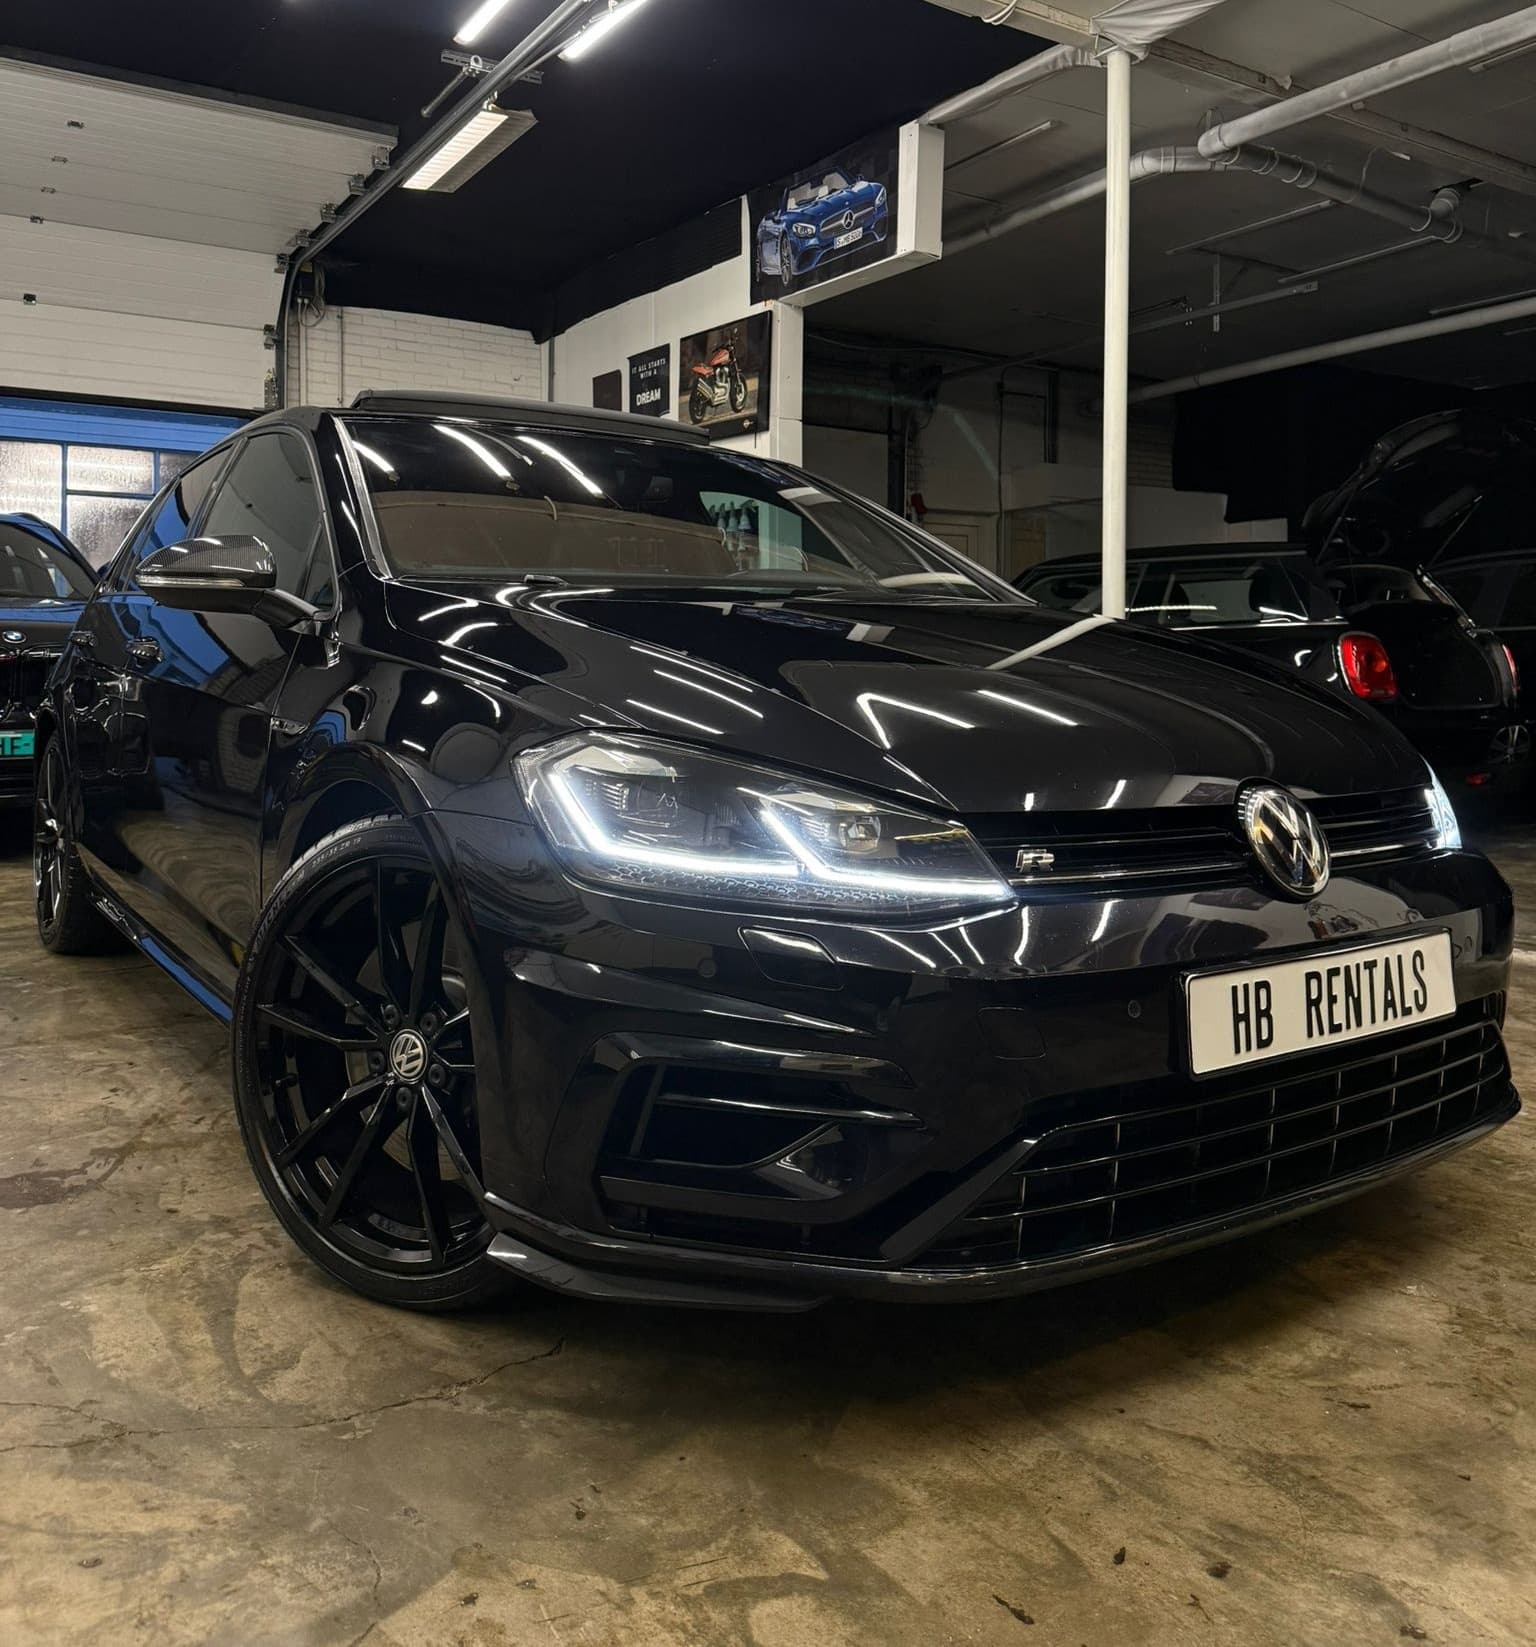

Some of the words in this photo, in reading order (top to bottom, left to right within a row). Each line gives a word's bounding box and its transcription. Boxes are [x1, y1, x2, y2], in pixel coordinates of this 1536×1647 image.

[648, 358, 666, 369] STARTS
[640, 371, 652, 379] WITH
[636, 388, 661, 406] DREAM
[1231, 979, 1274, 1055] HB
[1304, 949, 1428, 1039] RENTALS
